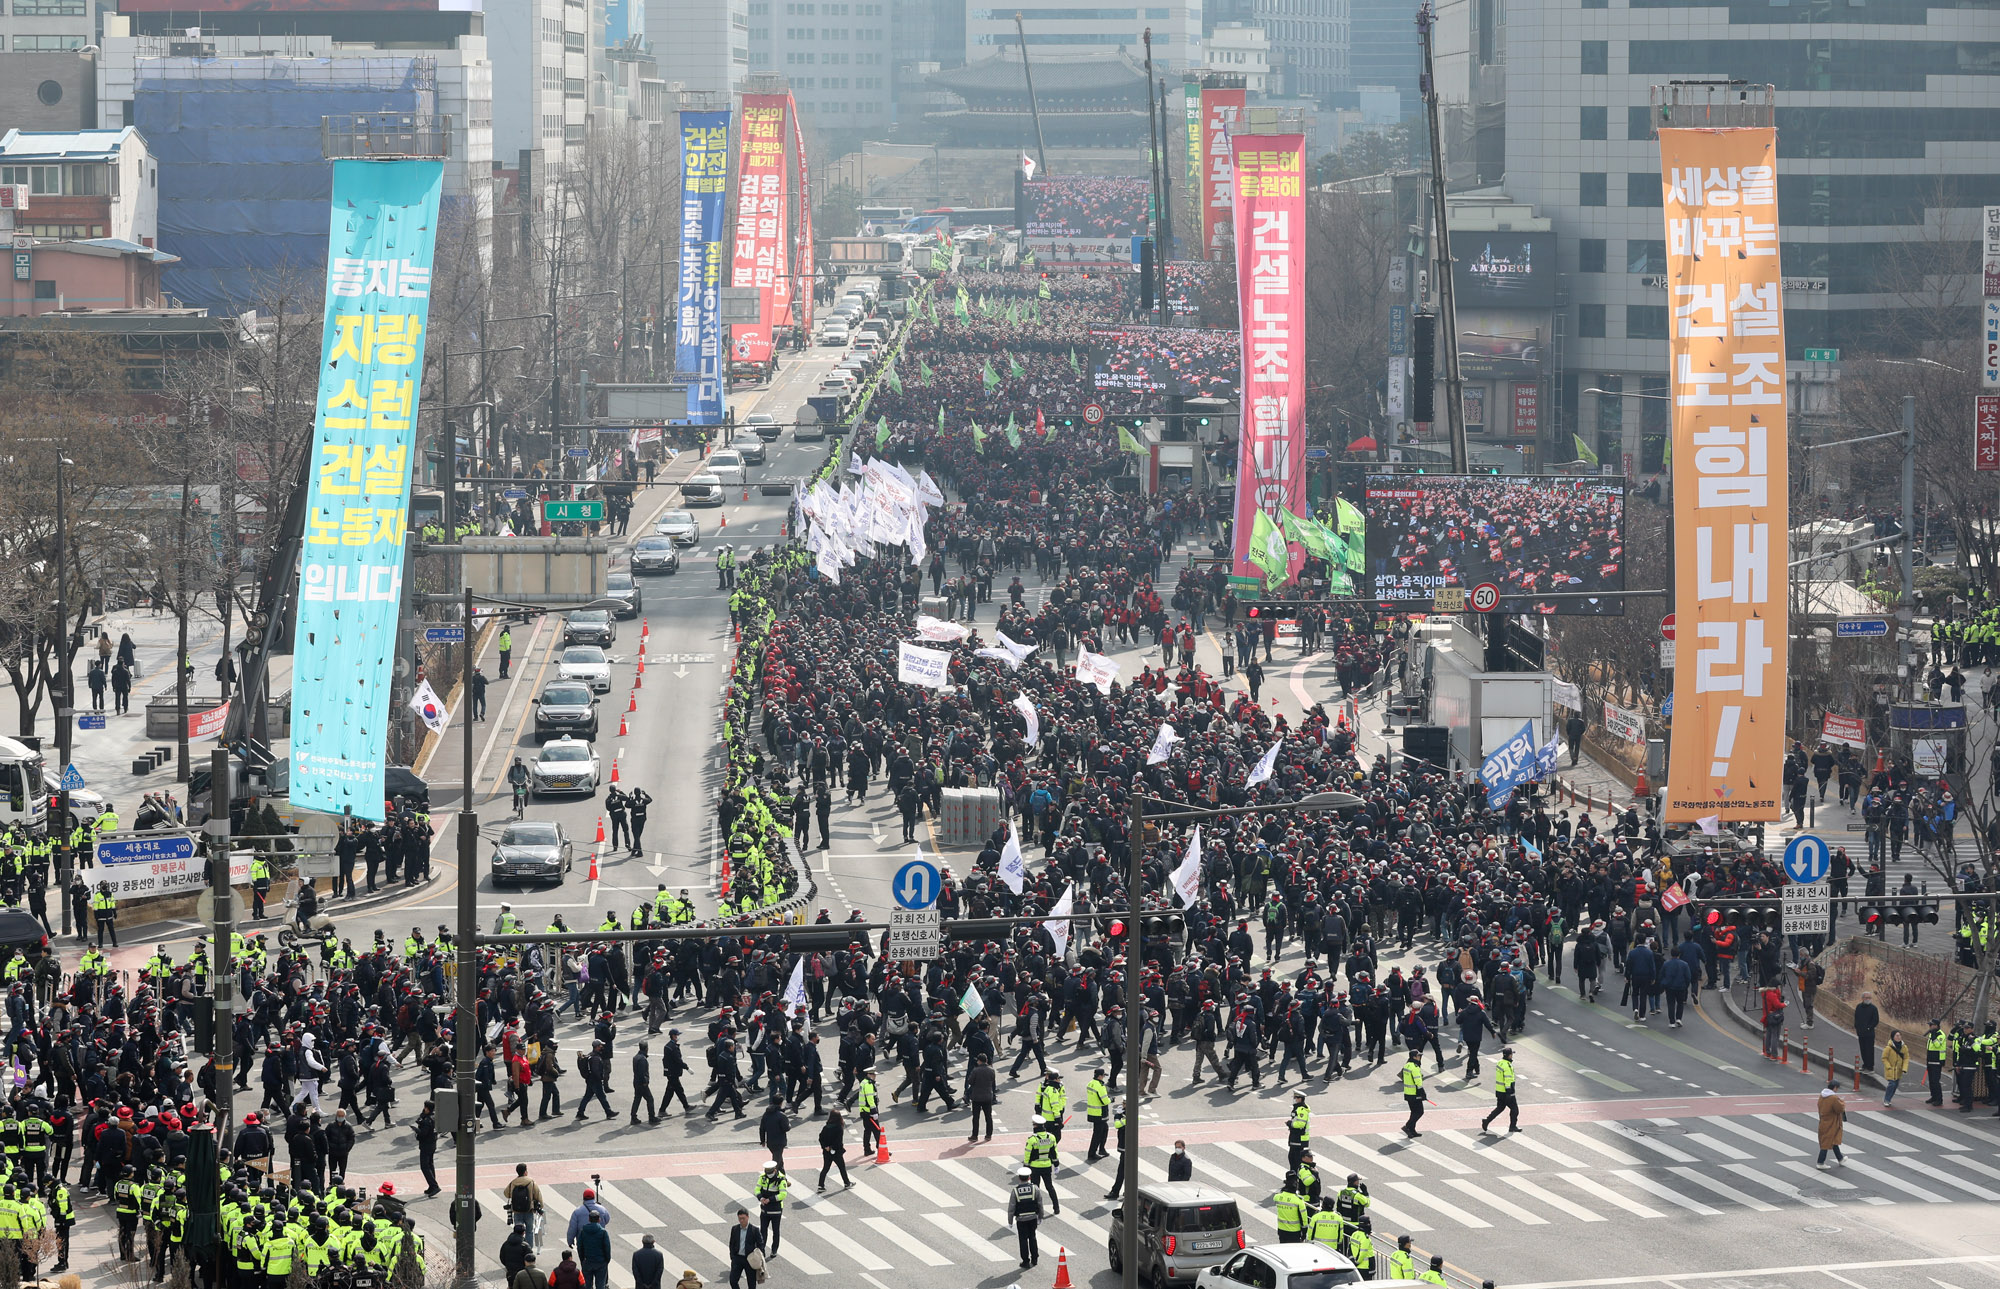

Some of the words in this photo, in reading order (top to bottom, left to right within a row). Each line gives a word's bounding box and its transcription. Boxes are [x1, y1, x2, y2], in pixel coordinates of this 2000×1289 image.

[744, 107, 783, 121] 건설의
[684, 126, 727, 151] 건설
[742, 141, 783, 154] 공무원의
[685, 151, 727, 176] 안전
[749, 155, 774, 168] 패기!
[1238, 151, 1300, 173] 든든해
[1239, 175, 1300, 198] 응원해
[1668, 165, 1774, 207] 세상을
[759, 174, 780, 238] 윤석열
[1669, 216, 1777, 257] 바꾸는
[754, 245, 776, 288] 심판
[1470, 264, 1533, 274] AMADEUS
[332, 258, 430, 298] 동지는
[1812, 281, 1823, 291] 4F
[1253, 210, 1290, 382] 건설노조
[1675, 282, 1780, 338] 건설
[679, 305, 703, 347] 함께
[331, 314, 423, 365] 자랑
[1676, 353, 1782, 406] 노조
[324, 379, 414, 430] 스런
[1087, 409, 1100, 420] 50
[1979, 414, 1998, 462] 손짜장
[319, 445, 407, 495] 건설
[556, 504, 592, 518] 시청
[307, 507, 408, 546] 노동자
[304, 564, 402, 602] 입니다
[1374, 575, 1397, 587] 살아
[1401, 575, 1447, 588] 움직이며
[1374, 588, 1421, 600] 실천하는
[1476, 590, 1494, 605] 50
[100, 850, 111, 859] 96
[125, 842, 161, 852] 세종대로
[176, 844, 190, 852] 100
[151, 861, 186, 873] 항복문서
[122, 877, 155, 892] 공동선언
[1785, 886, 1828, 899] 좌회전시
[893, 912, 938, 924] 좌회전시
[1784, 903, 1828, 916] 보행신호시
[892, 929, 938, 942] 보행신호시
